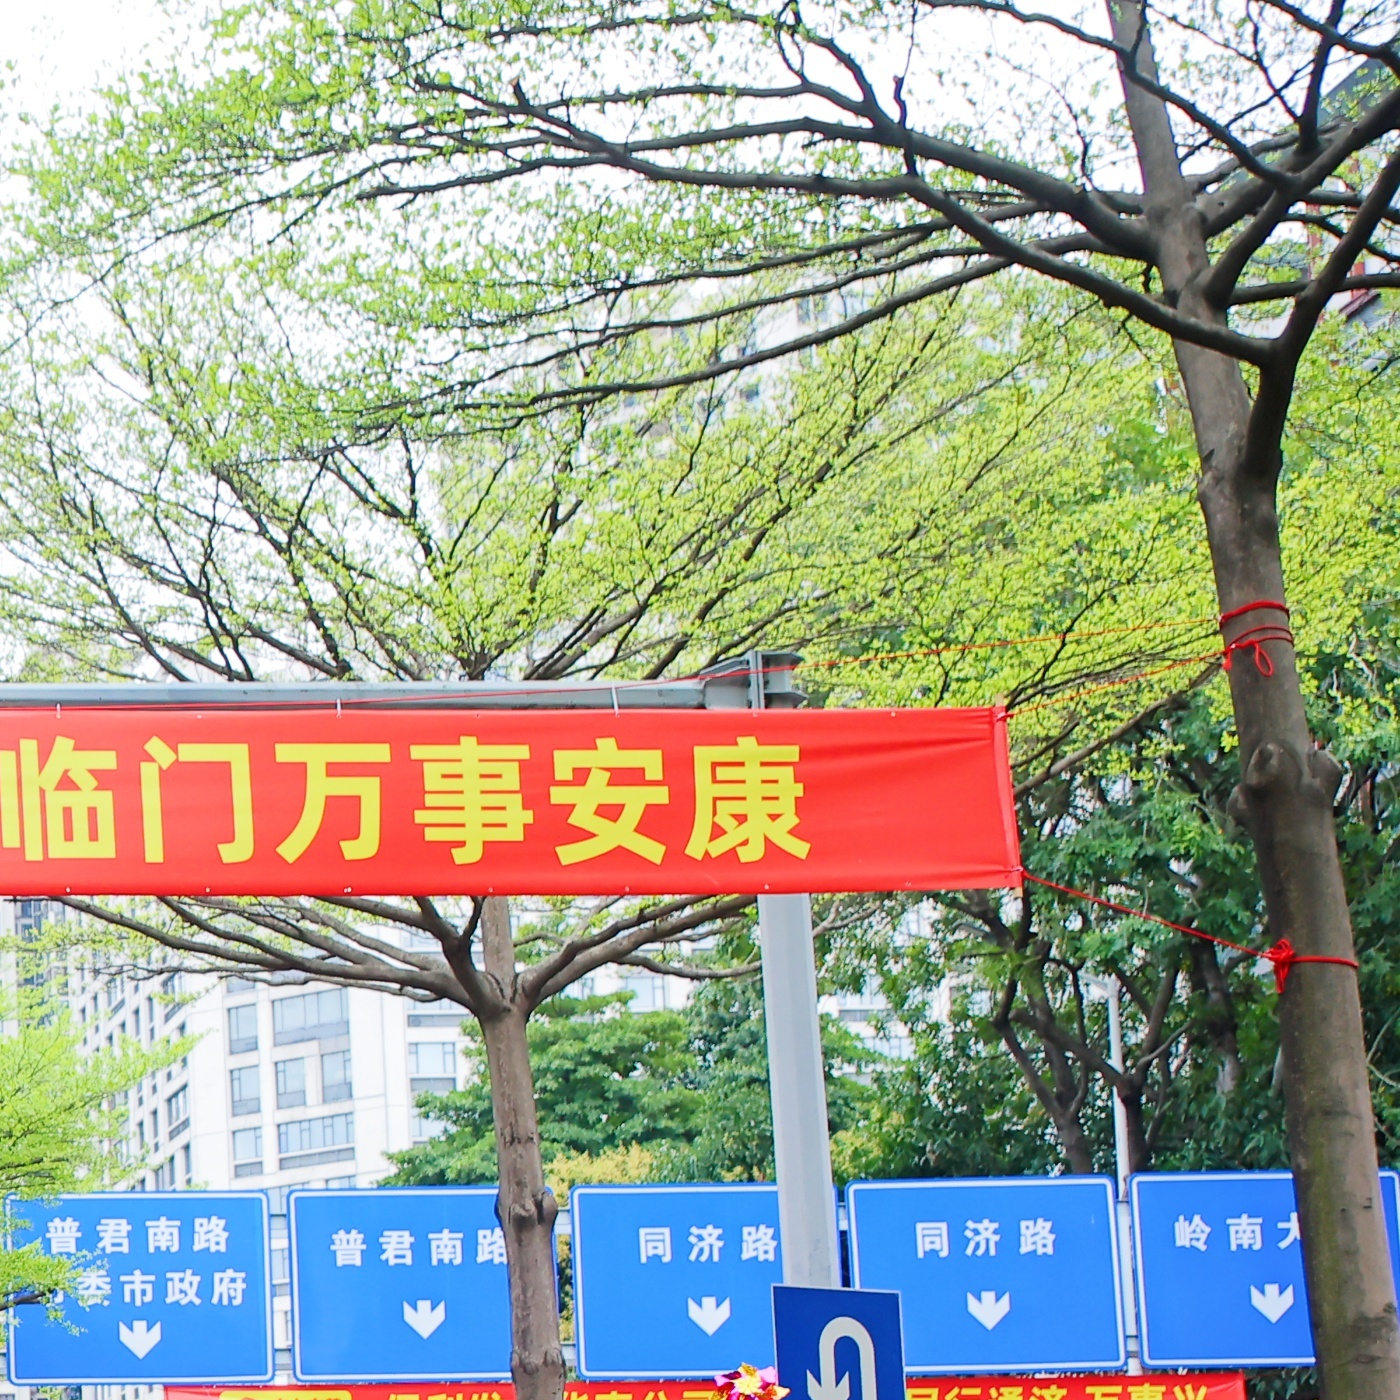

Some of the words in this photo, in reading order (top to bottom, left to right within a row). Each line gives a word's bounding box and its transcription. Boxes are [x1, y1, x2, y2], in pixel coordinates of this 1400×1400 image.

[46, 1215, 230, 1256] 普君南路
[329, 1227, 508, 1268] 普君南路
[638, 1222, 780, 1265] 同济路
[915, 1216, 1057, 1259] 同济路
[50, 1268, 248, 1308] 委市政府
